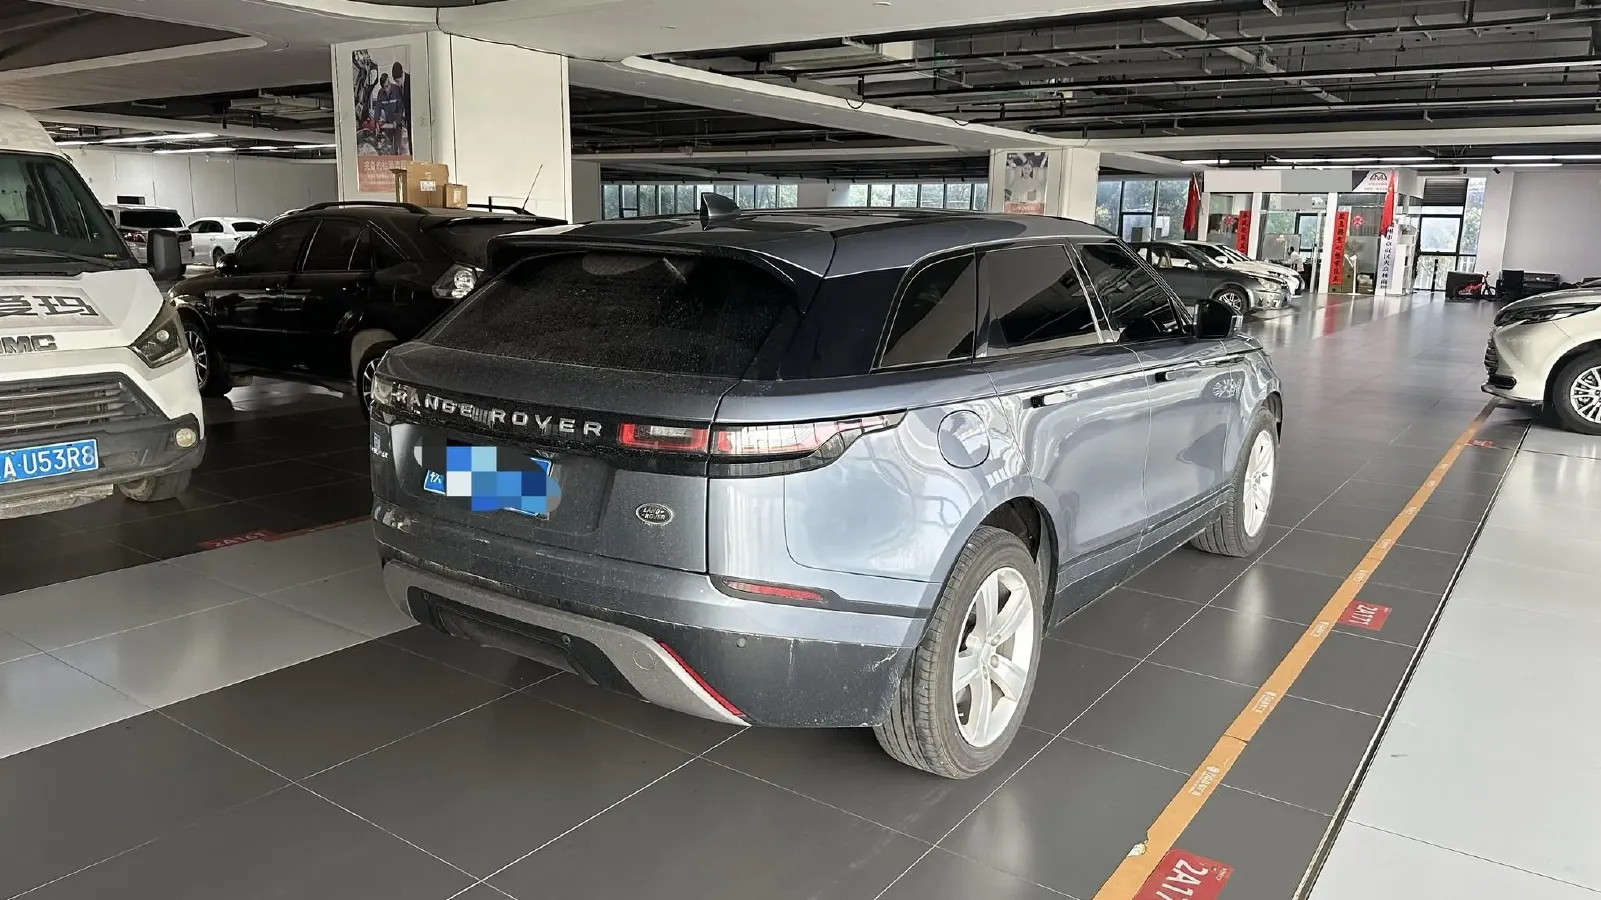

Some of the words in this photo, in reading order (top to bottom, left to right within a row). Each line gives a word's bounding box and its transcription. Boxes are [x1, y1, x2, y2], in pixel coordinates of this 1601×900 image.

[0, 335, 57, 353] MC
[393, 384, 476, 419] RANGE
[489, 408, 602, 436] ROVER
